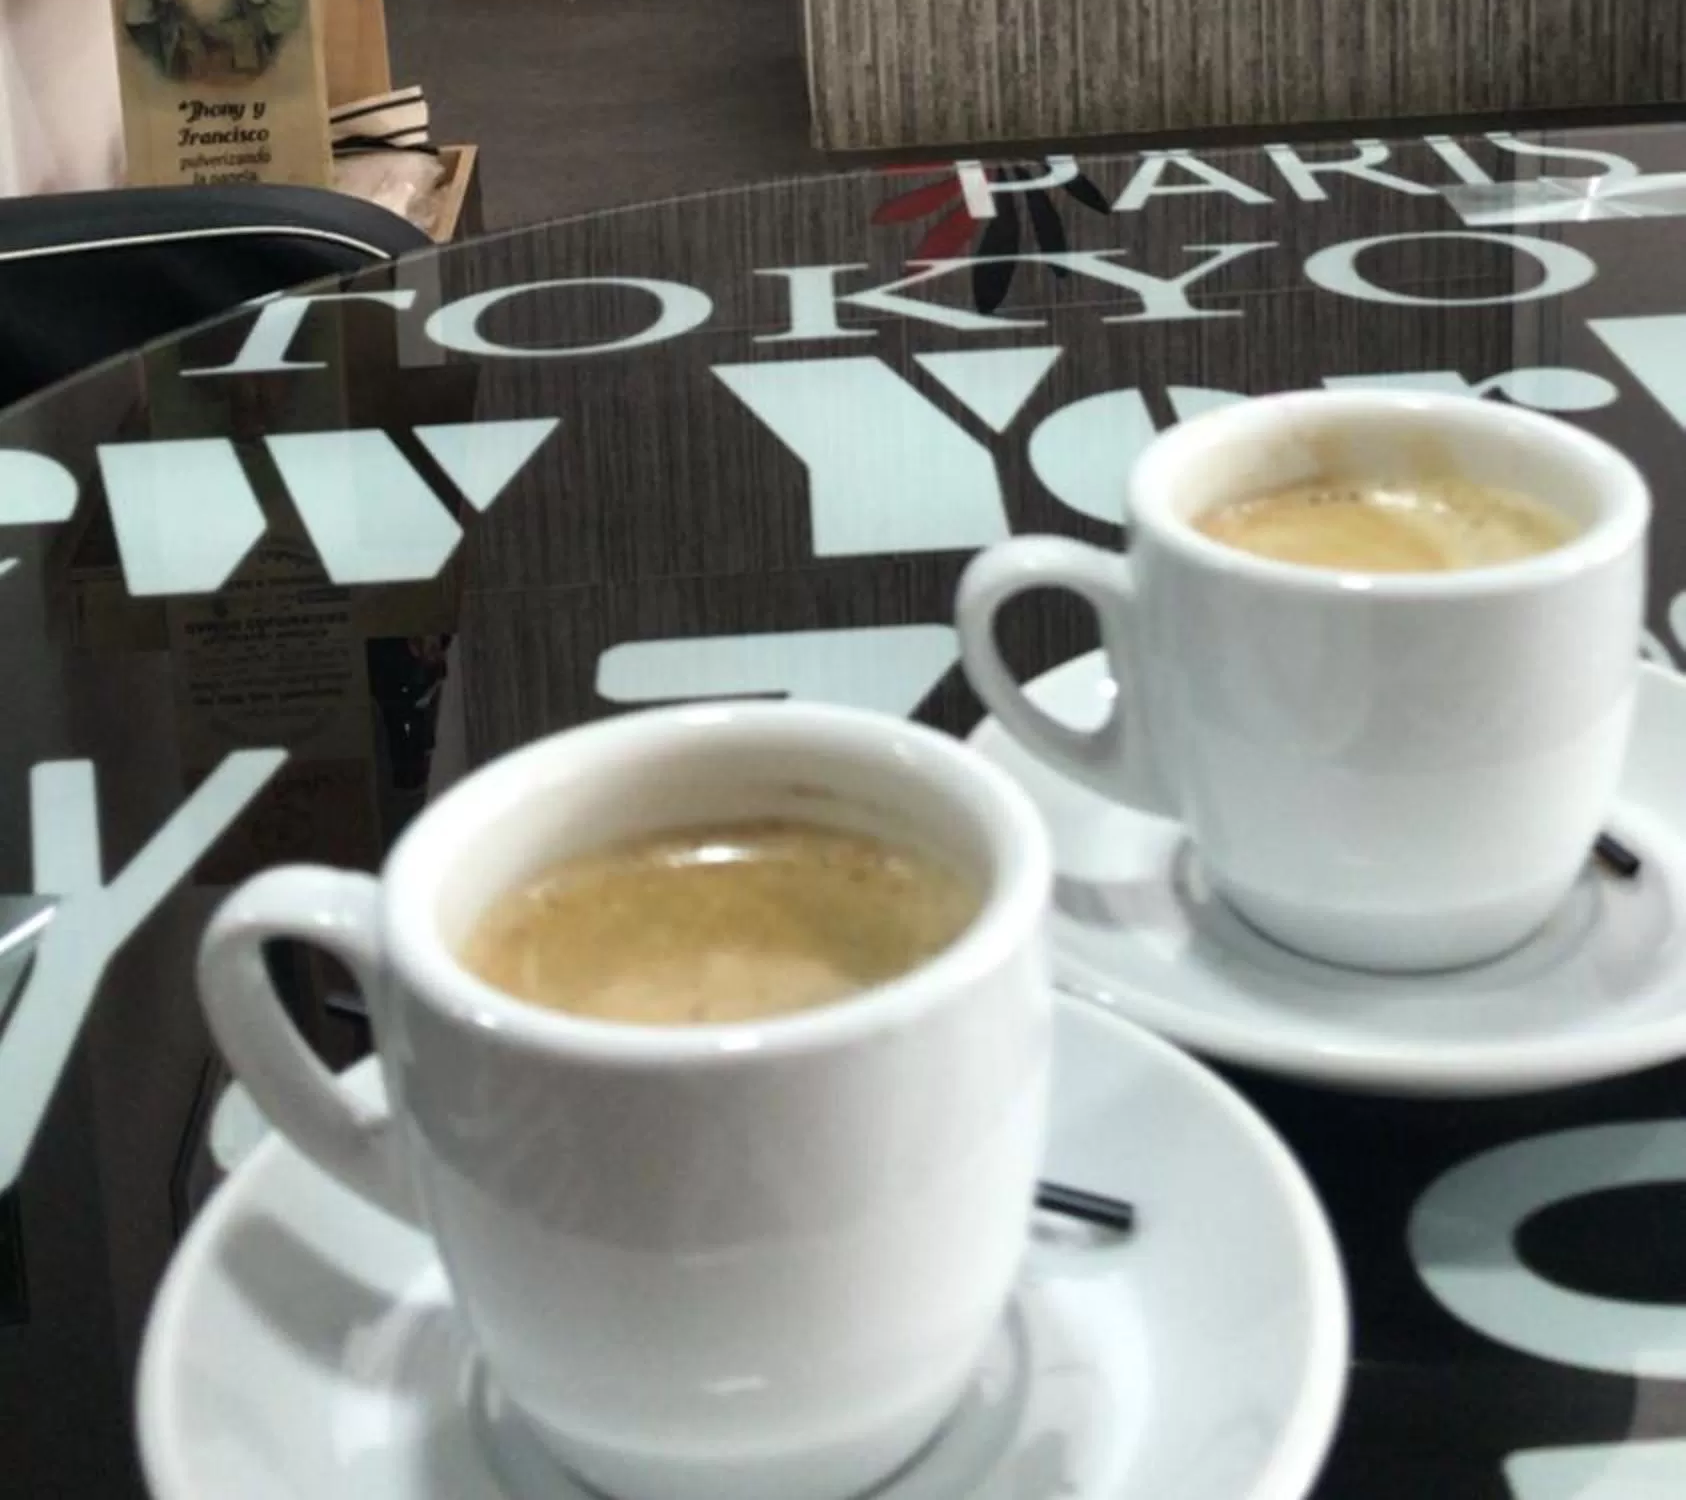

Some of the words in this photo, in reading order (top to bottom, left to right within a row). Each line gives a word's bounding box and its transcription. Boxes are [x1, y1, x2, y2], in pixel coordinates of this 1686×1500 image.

[252, 101, 266, 120] y
[178, 126, 270, 147] Francisco
[179, 148, 272, 171] pulverizando
[955, 132, 1640, 222] PARIS
[180, 232, 1597, 376] TOKYO
